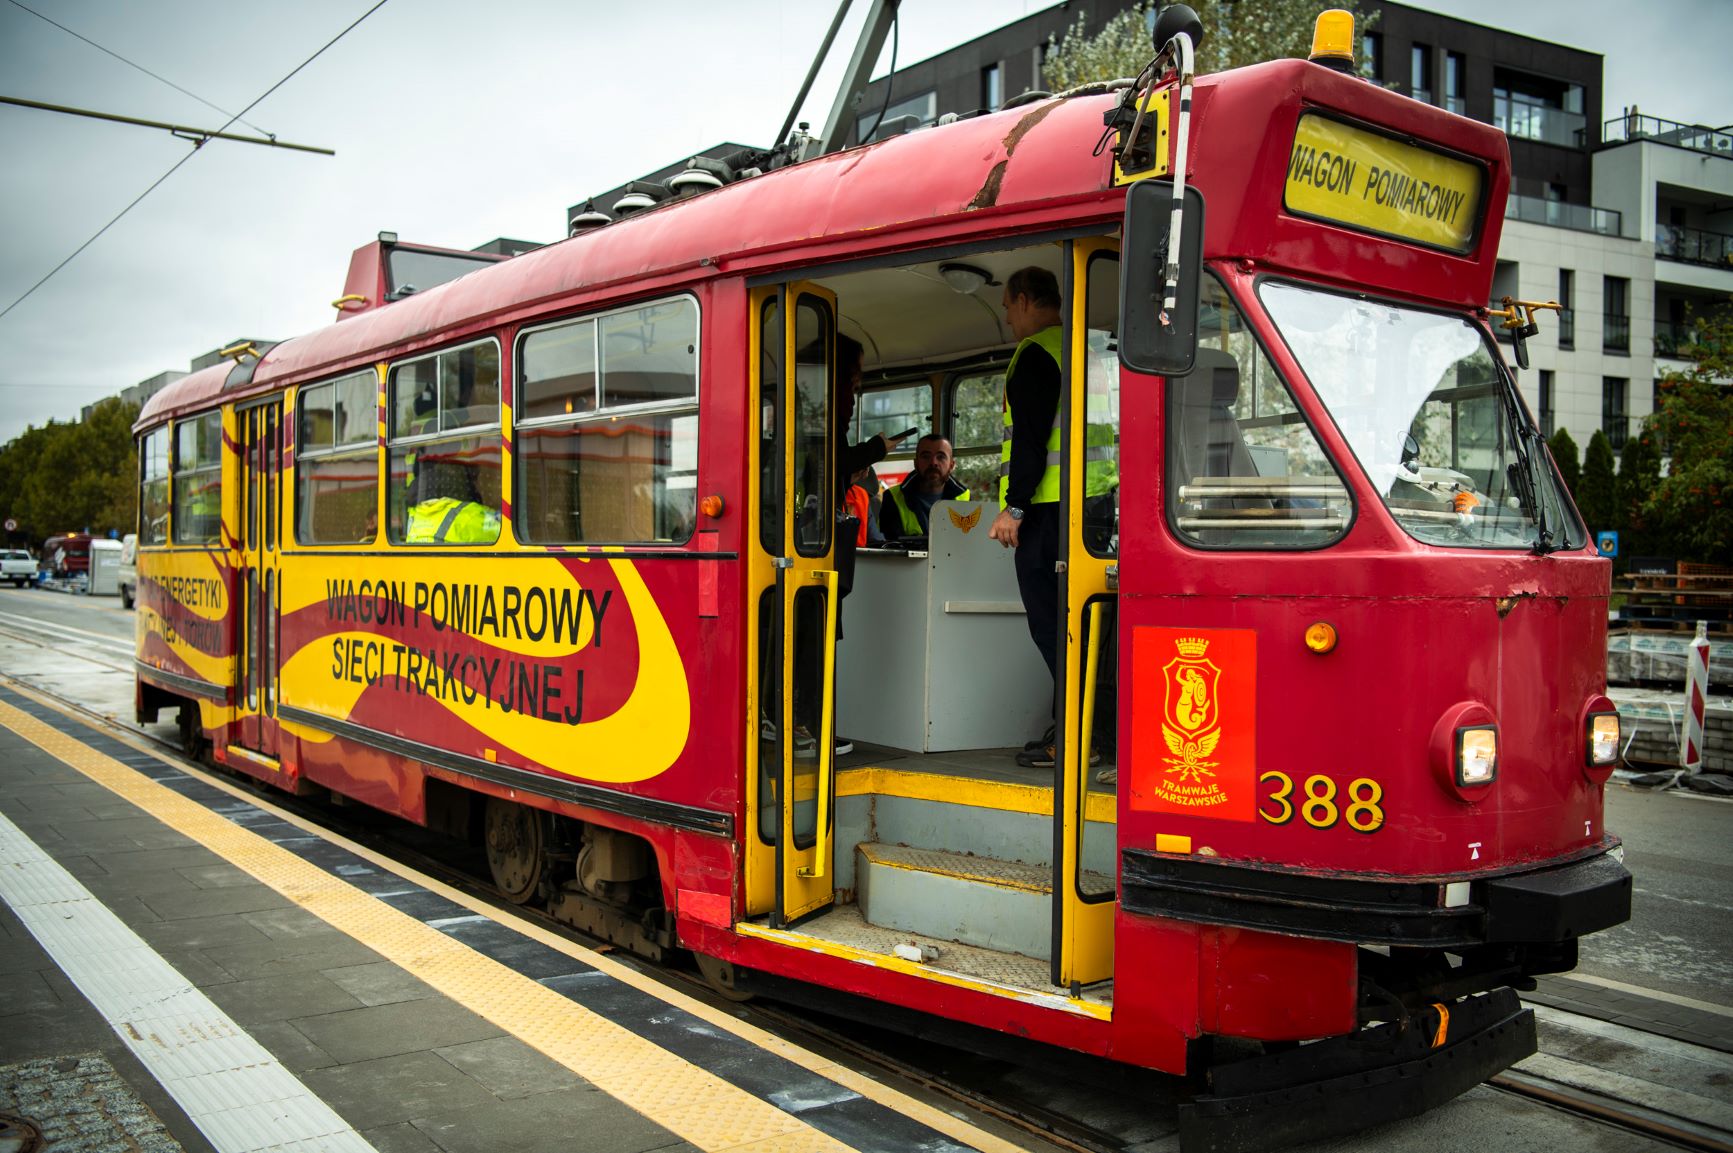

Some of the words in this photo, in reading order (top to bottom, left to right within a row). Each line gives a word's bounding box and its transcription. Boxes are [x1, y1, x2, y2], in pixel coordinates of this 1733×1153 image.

[1287, 144, 1357, 195] WAGON
[1363, 166, 1465, 225] POMIAROWY
[326, 579, 406, 627] WAGON
[413, 581, 613, 648] POMIAROWY
[332, 636, 385, 688] SIECI
[392, 642, 585, 726] TRAKCYJNEJ
[1154, 786, 1228, 806] WARSZAWSKIE
[1163, 779, 1219, 795] TRAMWAJE
[1258, 770, 1386, 834] 388
